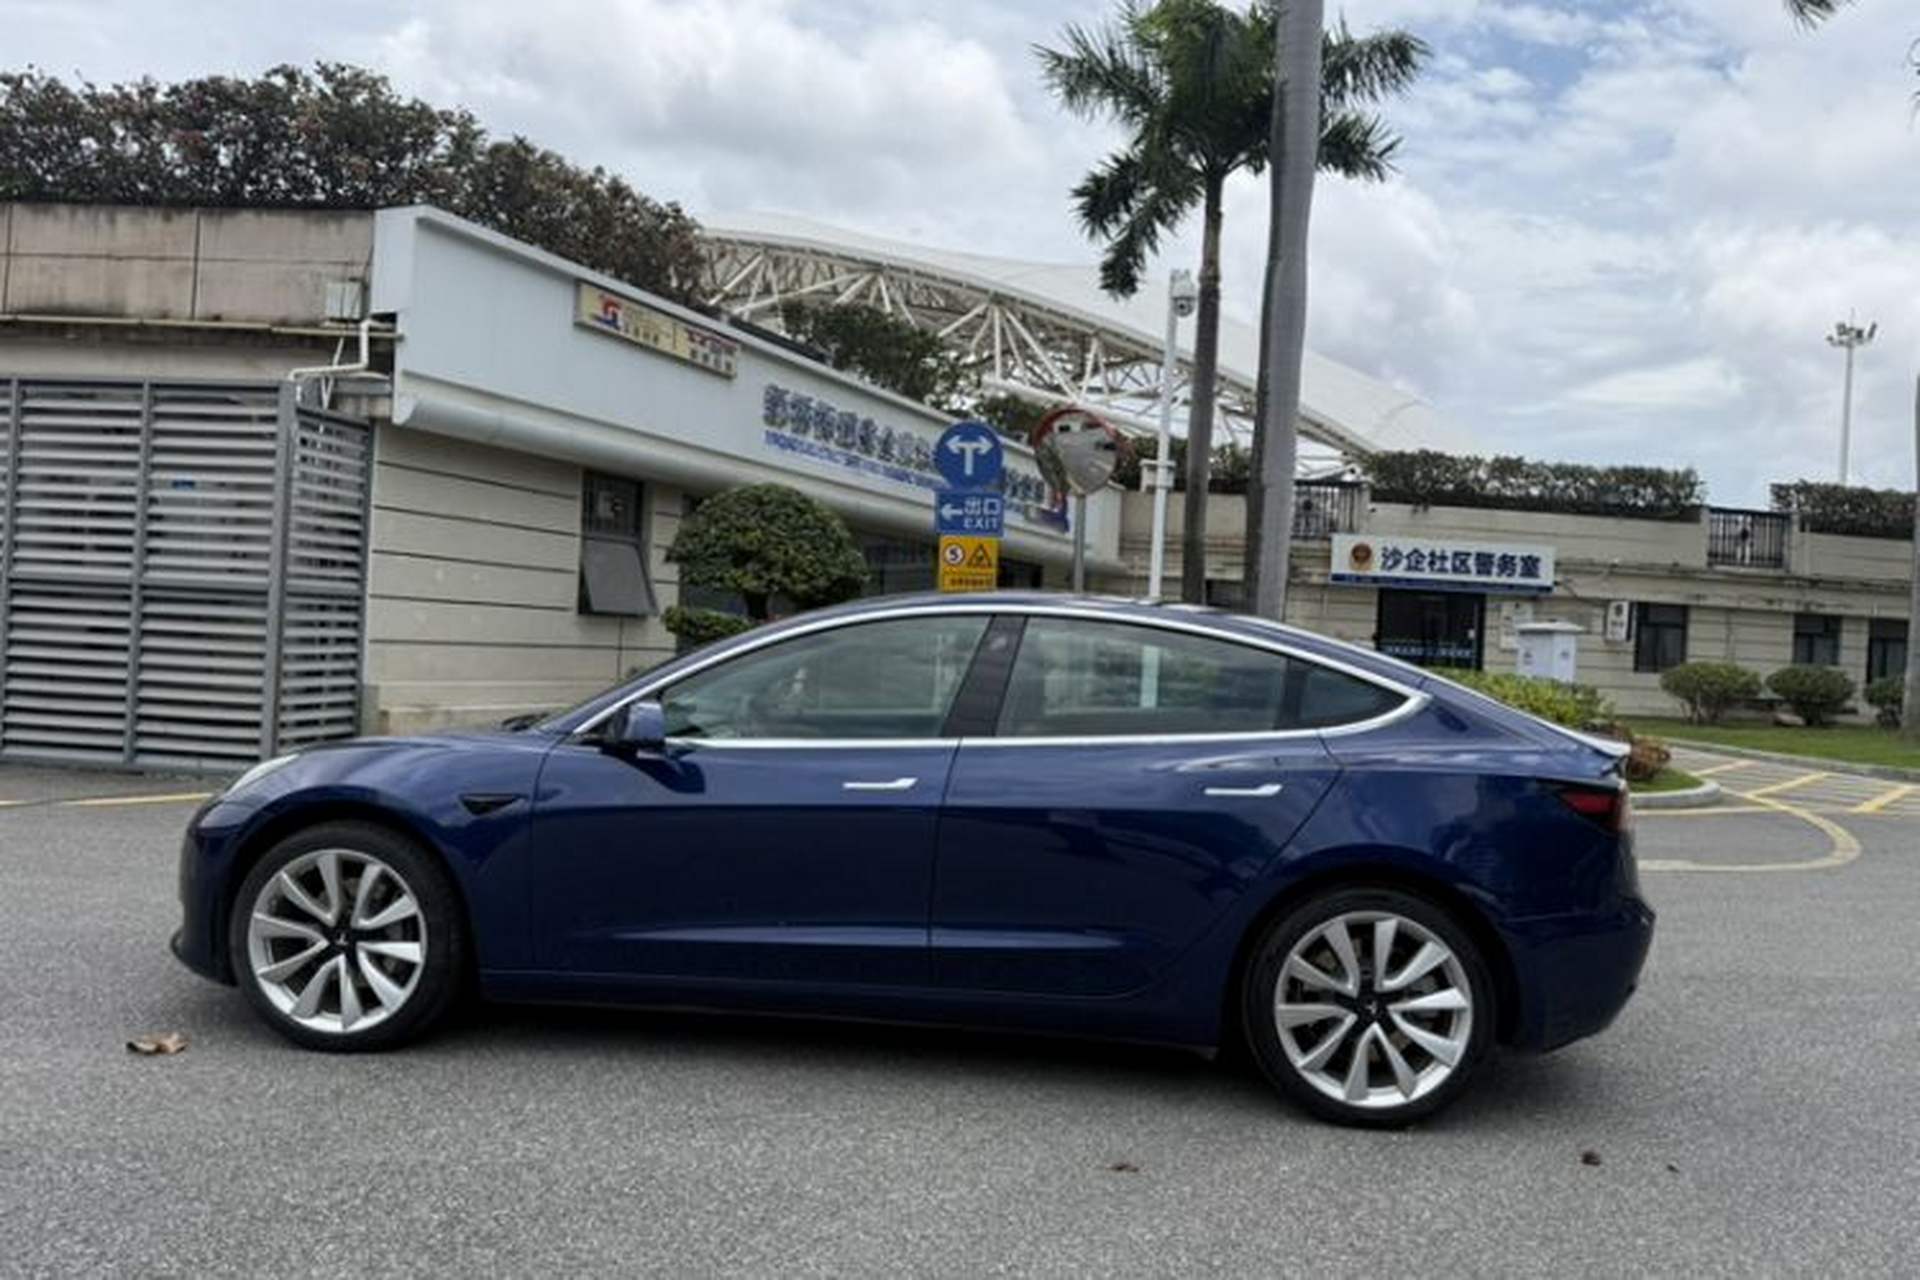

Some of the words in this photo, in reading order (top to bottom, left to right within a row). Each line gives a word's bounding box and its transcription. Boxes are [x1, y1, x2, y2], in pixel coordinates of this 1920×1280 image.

[964, 496, 1000, 515] 出口
[963, 516, 998, 530] EXIT
[1380, 546, 1541, 578] 沙企社区警务室
